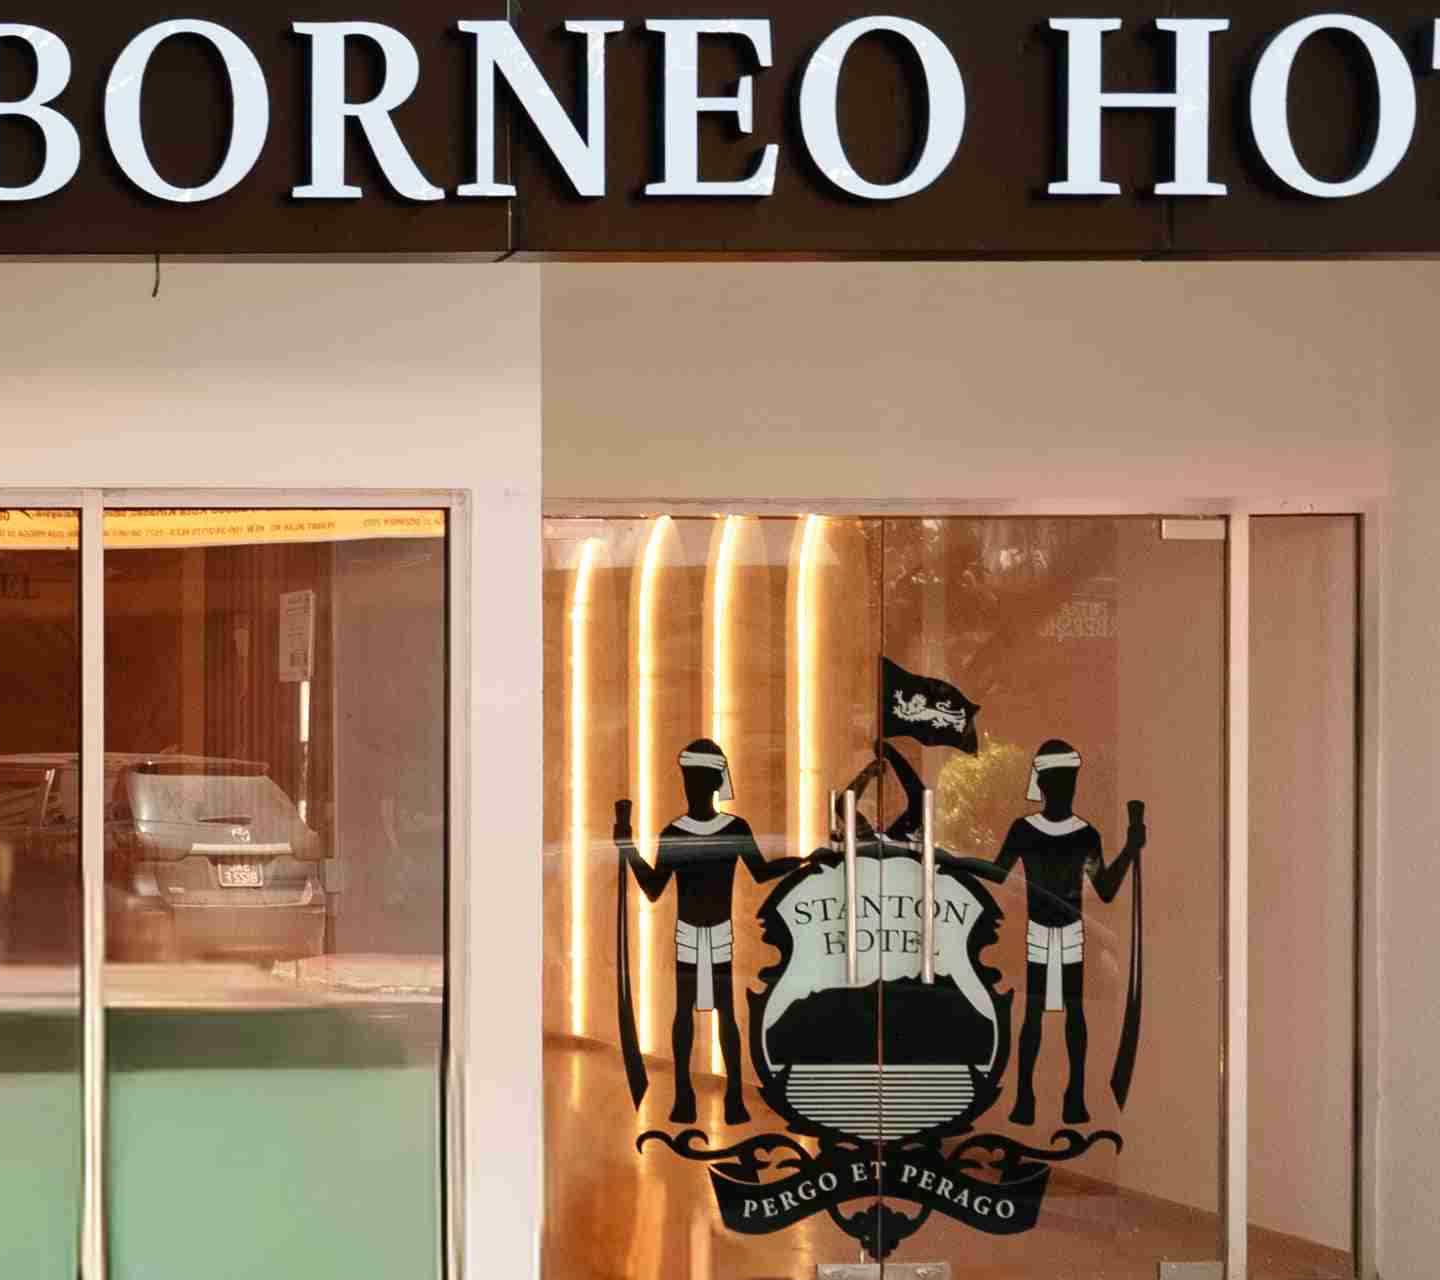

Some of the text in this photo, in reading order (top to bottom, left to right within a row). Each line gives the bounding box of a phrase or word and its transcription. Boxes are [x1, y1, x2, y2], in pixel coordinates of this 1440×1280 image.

[743, 1161, 1015, 1219] PERGO ET PERAGO
